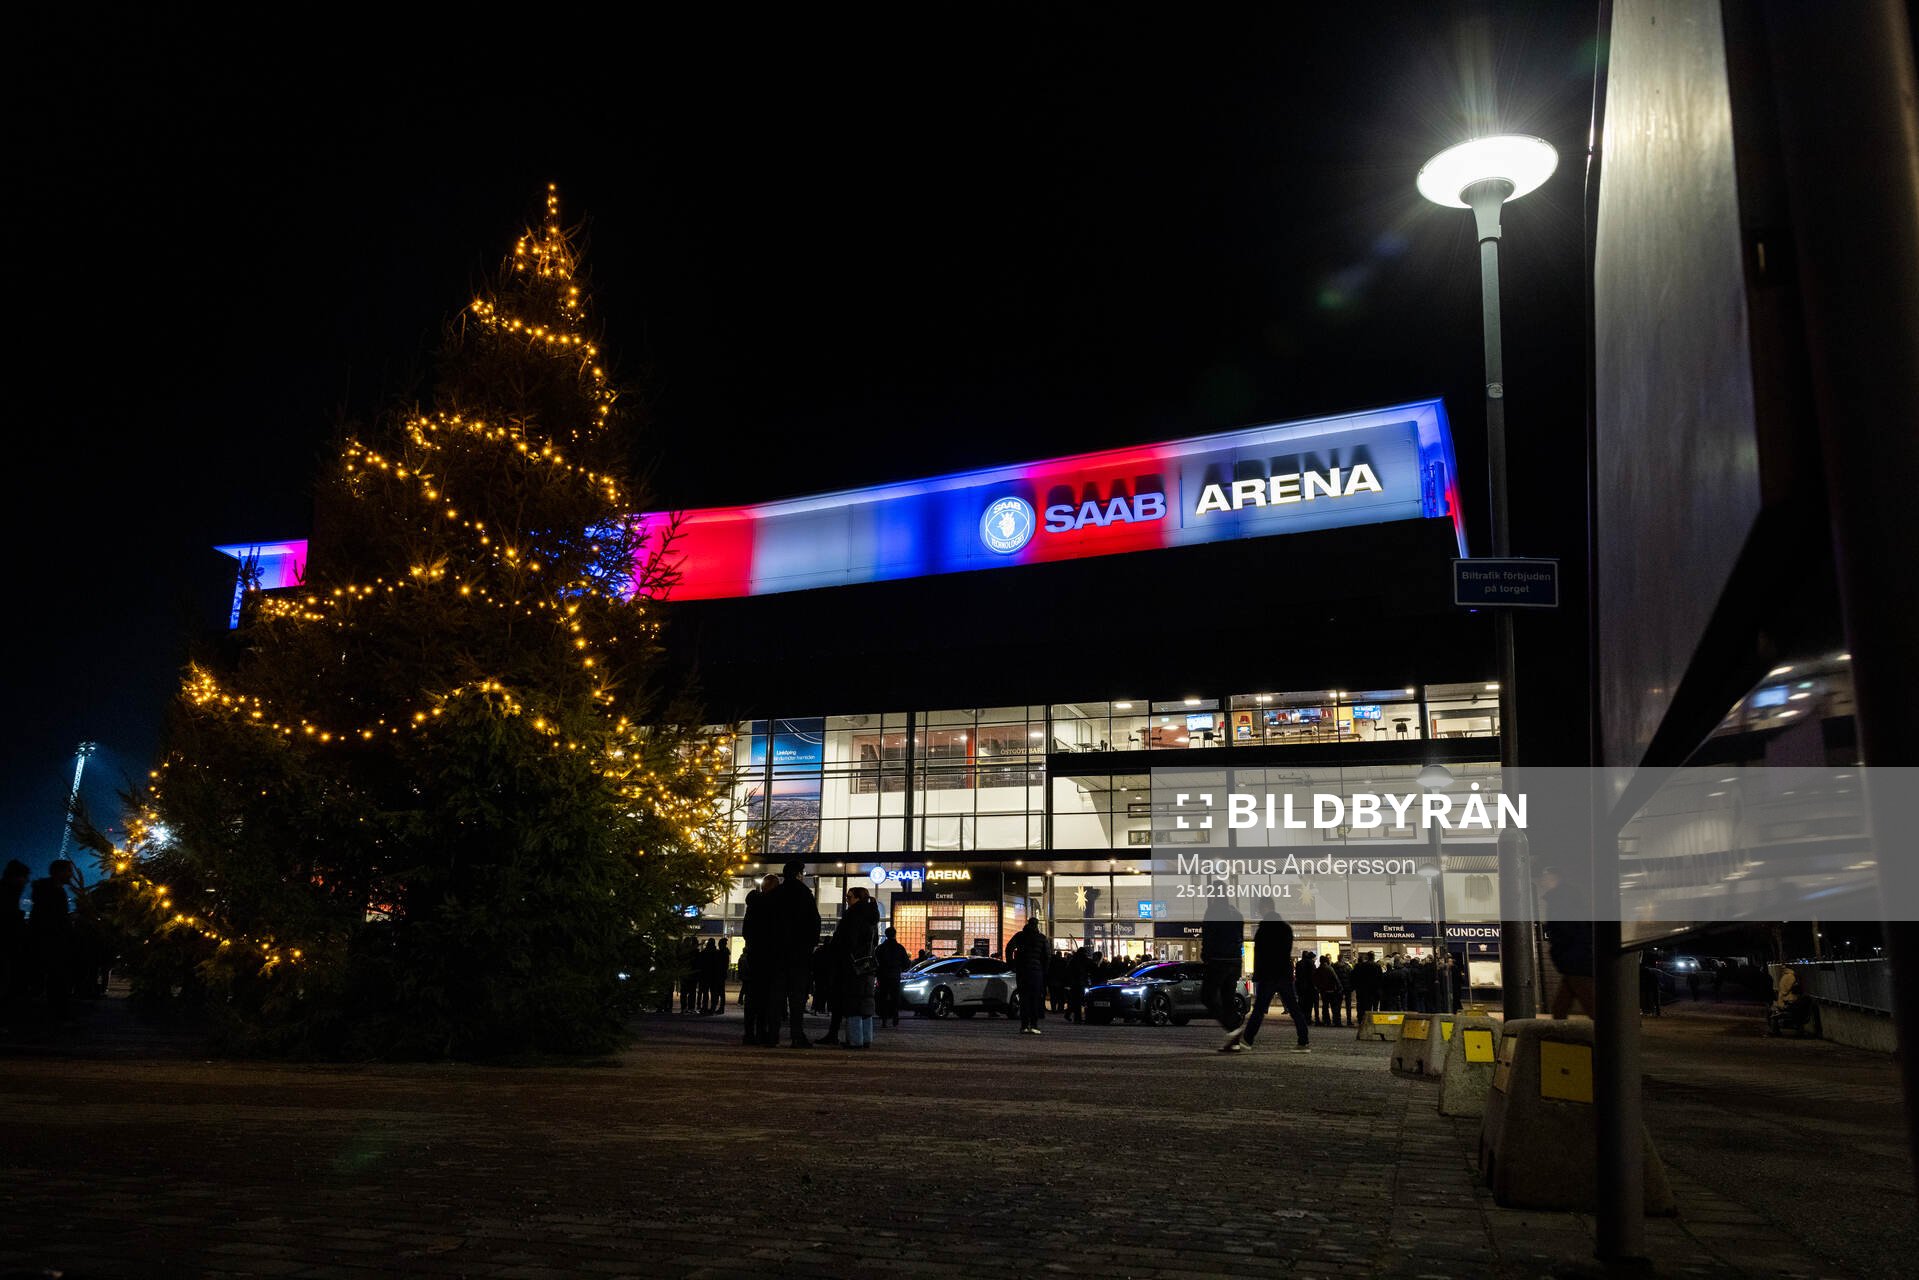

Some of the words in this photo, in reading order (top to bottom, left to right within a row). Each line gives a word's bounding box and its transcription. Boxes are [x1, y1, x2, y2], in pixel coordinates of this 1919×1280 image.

[1044, 492, 1167, 534] SAAB
[1195, 463, 1384, 516] ARENA
[993, 501, 1022, 514] SAAB
[1462, 571, 1500, 581] Biltrafik
[1503, 571, 1551, 582] förbjuden
[1484, 584, 1497, 595] på
[1500, 585, 1530, 595] torget
[888, 870, 920, 880] SAAB
[926, 869, 971, 880] ARENA
